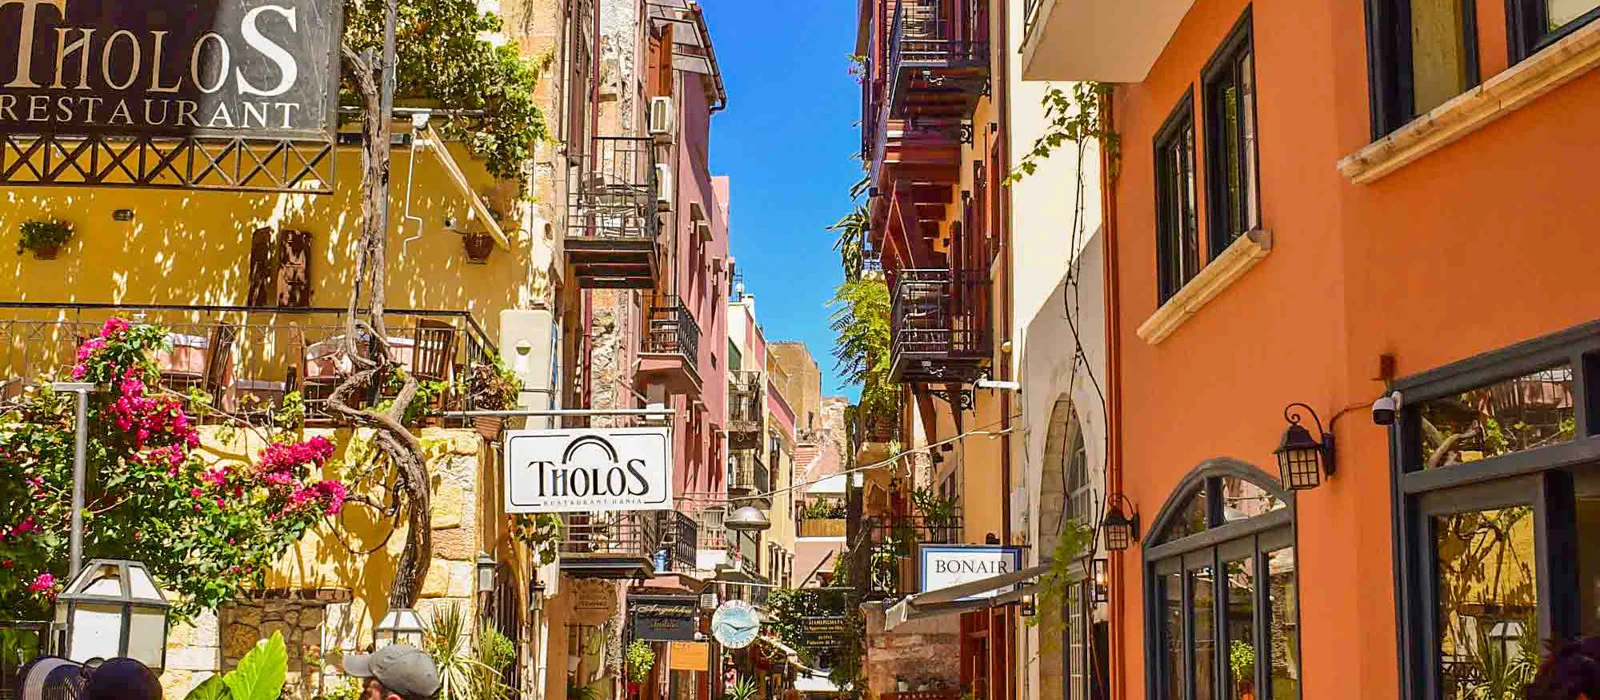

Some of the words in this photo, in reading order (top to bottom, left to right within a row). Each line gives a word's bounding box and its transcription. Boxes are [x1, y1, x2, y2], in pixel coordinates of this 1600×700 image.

[0, 0, 298, 97] THOLOS
[0, 95, 300, 129] RESTAURANT
[526, 459, 650, 497] THOLOS
[935, 559, 1009, 574] BONAIR
